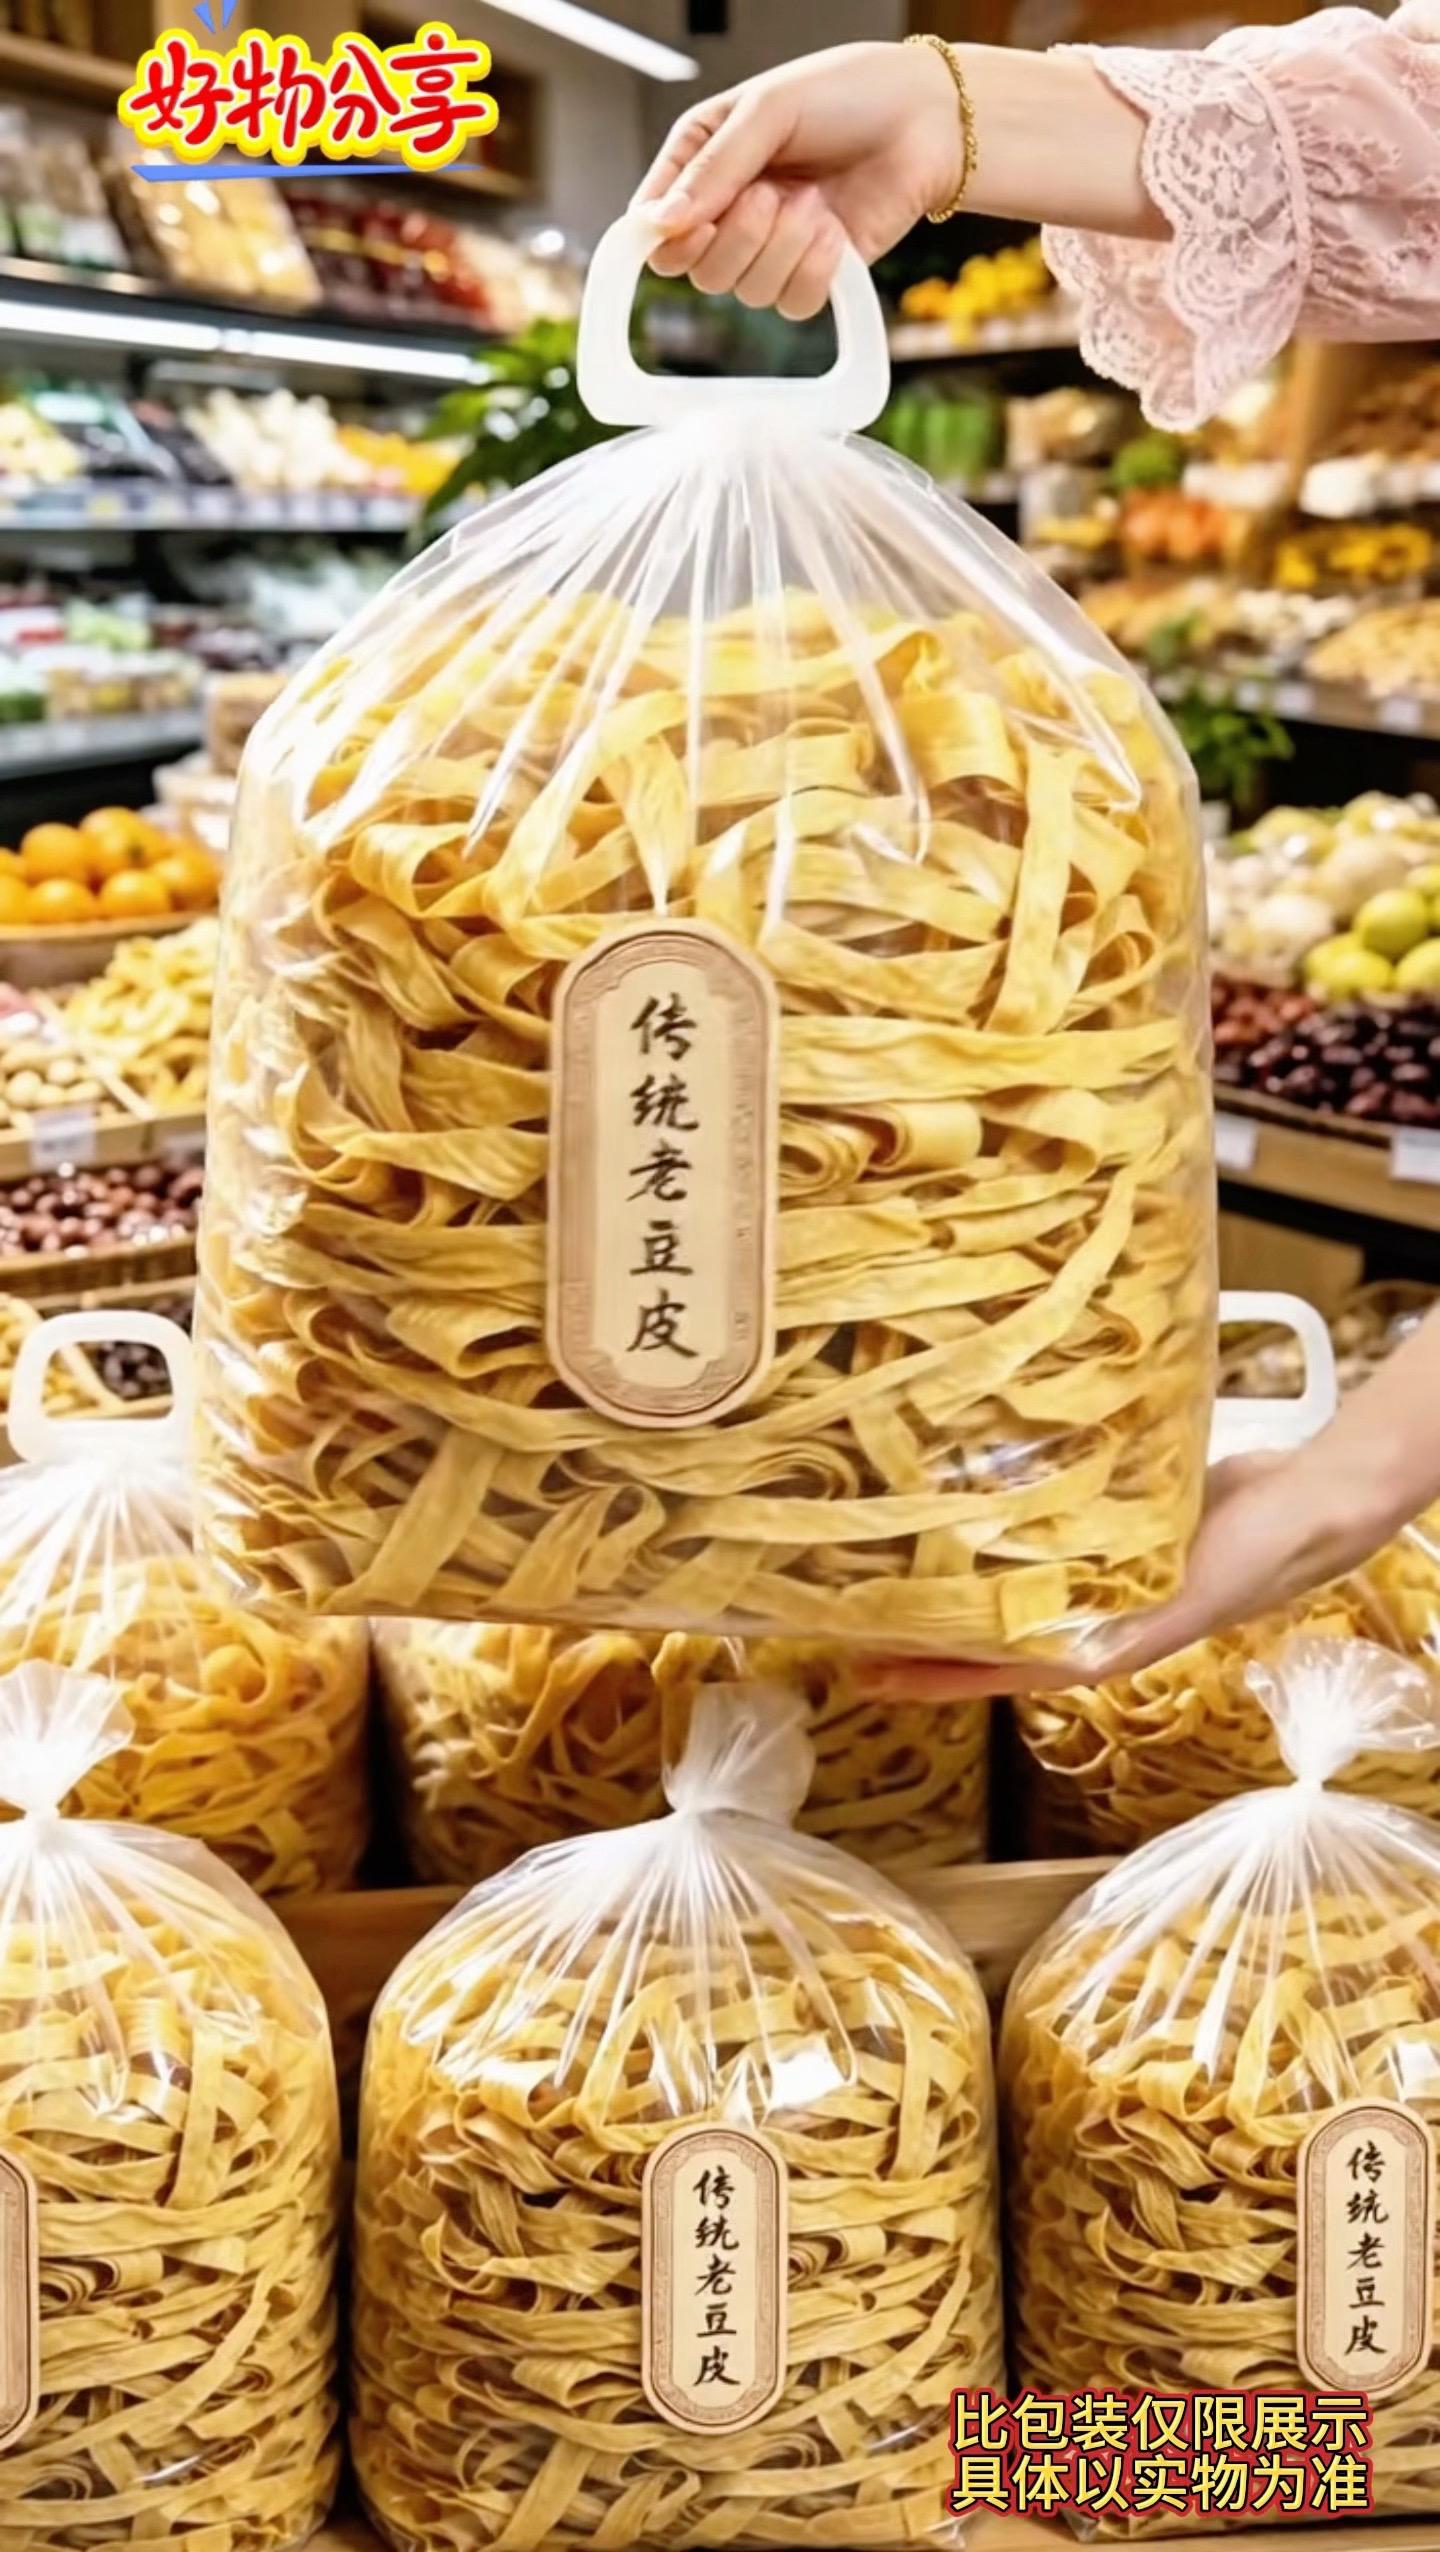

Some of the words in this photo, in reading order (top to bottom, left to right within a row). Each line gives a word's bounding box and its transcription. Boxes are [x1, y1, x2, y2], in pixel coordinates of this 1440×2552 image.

[626, 991, 700, 1358] 传统老豆皮
[692, 2163, 742, 2388] 传统老豆皮
[1344, 2139, 1390, 2357] 传统老豆皮
